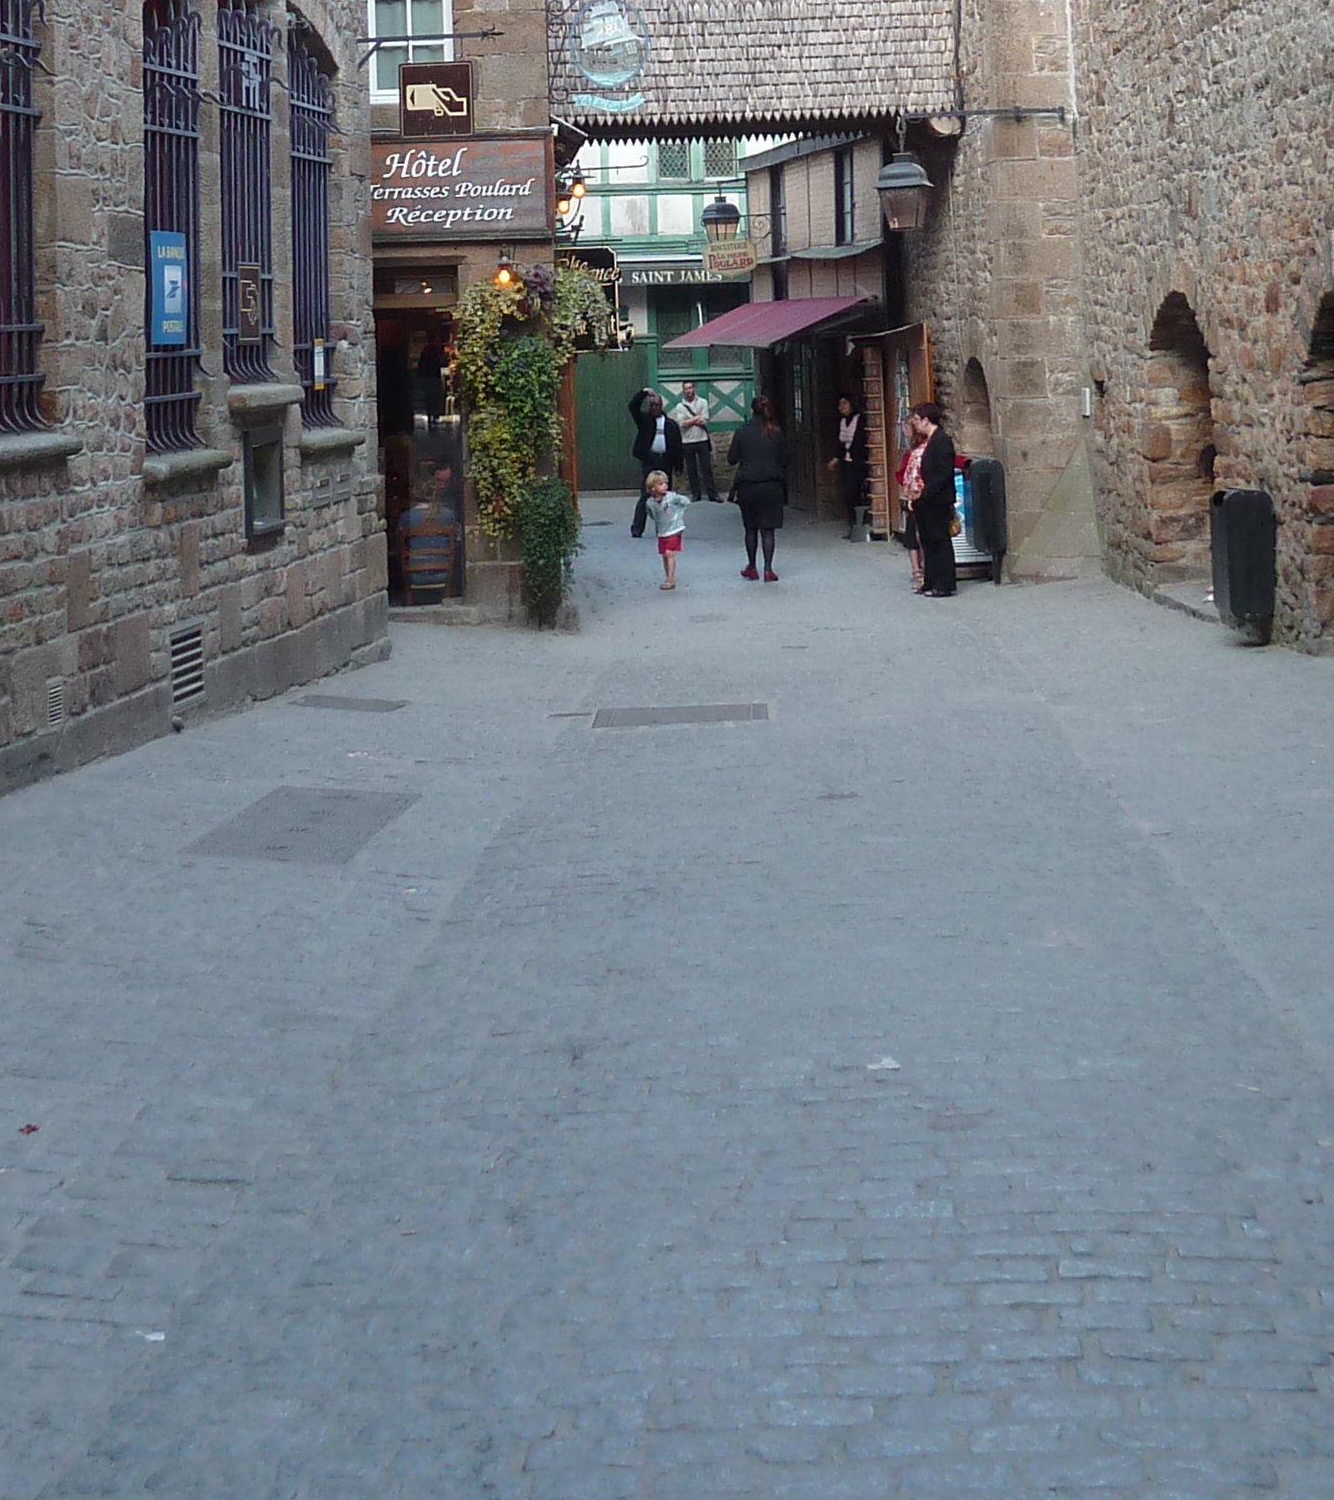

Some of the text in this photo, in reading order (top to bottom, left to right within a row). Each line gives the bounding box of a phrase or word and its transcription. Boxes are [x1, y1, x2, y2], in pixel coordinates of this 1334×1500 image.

[382, 147, 468, 179] Hôtel
[454, 178, 536, 198] Poulard
[385, 204, 514, 229] Réception
[631, 271, 673, 283] SAINT
